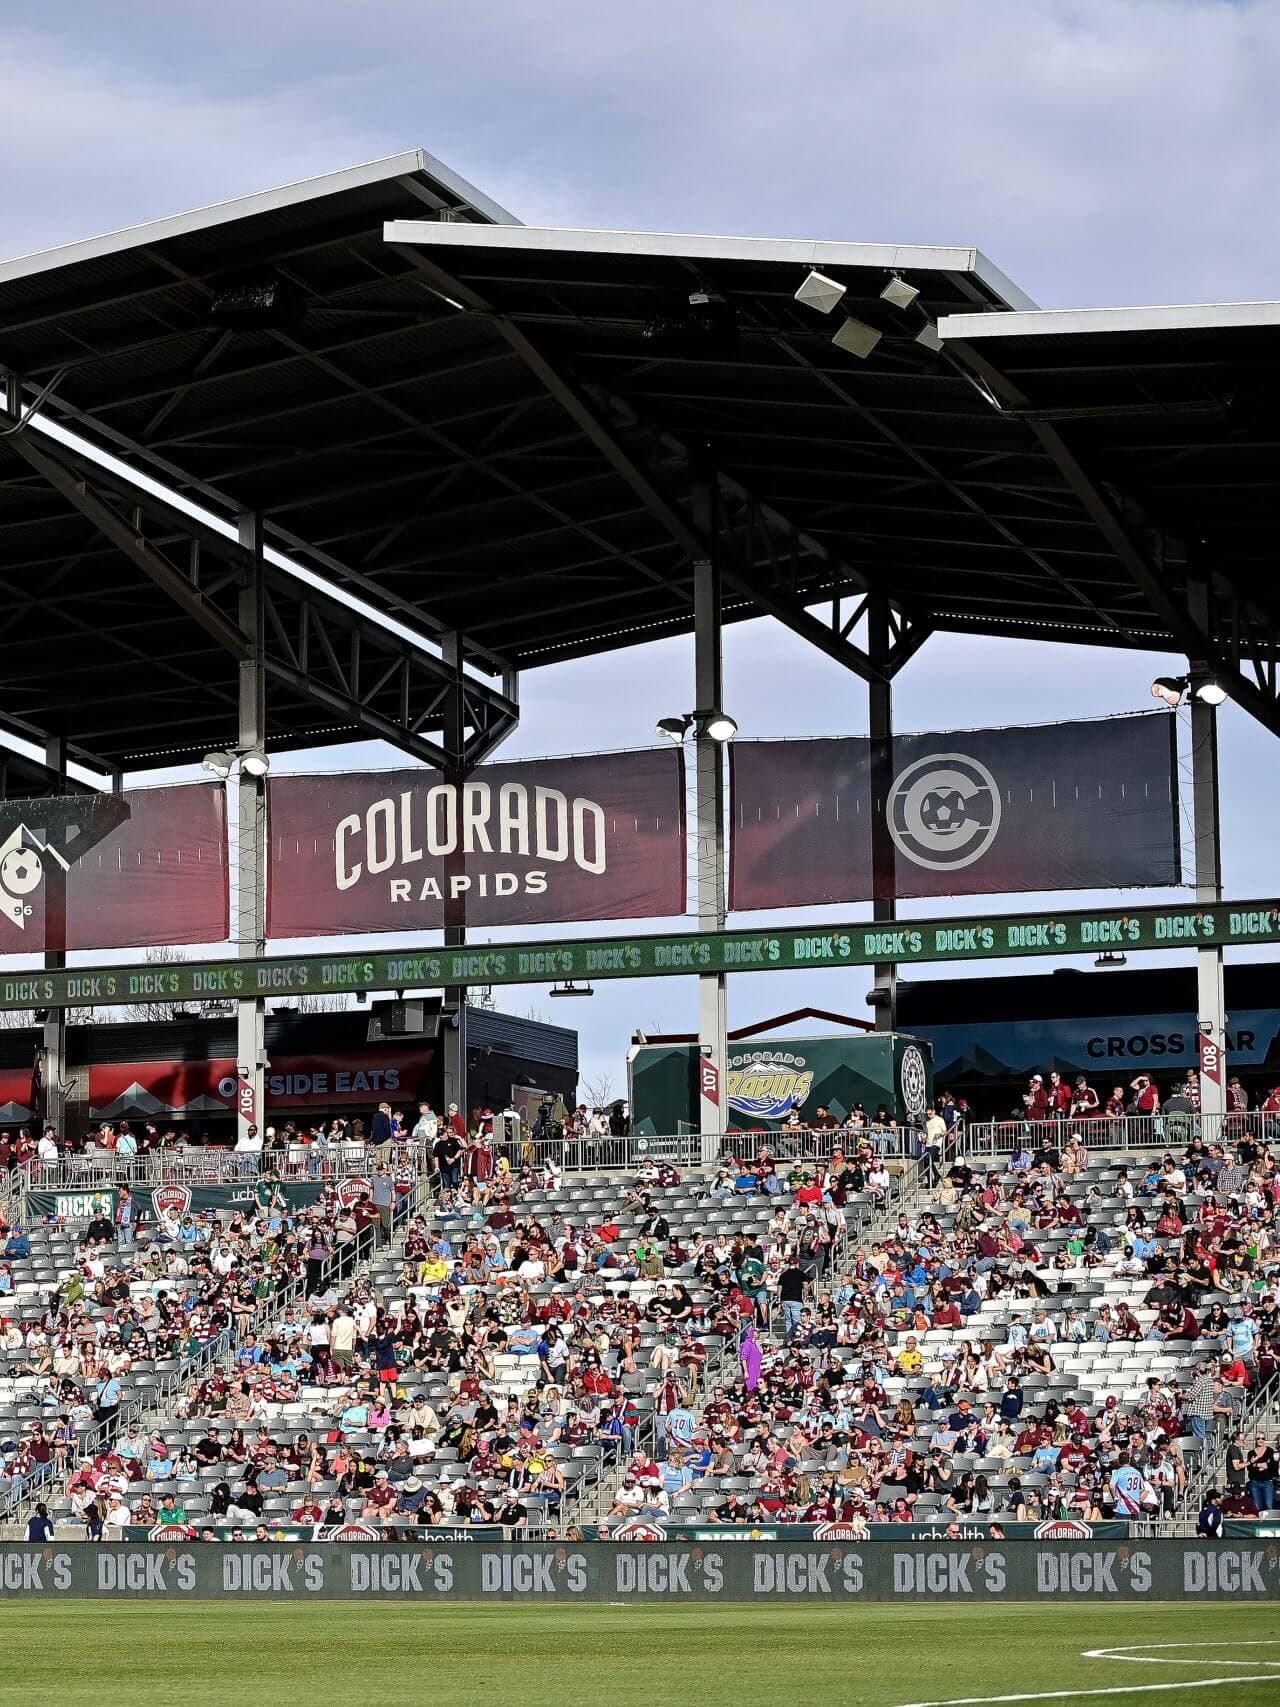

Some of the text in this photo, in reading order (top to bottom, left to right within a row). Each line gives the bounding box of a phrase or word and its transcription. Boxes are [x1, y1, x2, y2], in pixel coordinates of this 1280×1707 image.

[335, 781, 606, 891] COLORADO
[390, 871, 548, 903] RAPIDS
[14, 905, 33, 916] 96
[6, 980, 52, 1001] DICKS
[68, 977, 115, 998] DICKS
[586, 945, 639, 970] DICK'S
[655, 941, 709, 966] DICK'S
[724, 937, 779, 963] DICK'S
[794, 933, 850, 959] DICK'S
[865, 929, 920, 955] DICK'S
[936, 925, 992, 951] DICK'S
[1008, 921, 1066, 947] DICK'S
[1082, 917, 1139, 943] DICK'S
[1156, 912, 1213, 939] DICK'S
[1230, 908, 1280, 935] DICK'
[1087, 1033, 1184, 1058] CROSS
[1203, 1045, 1217, 1072] 108
[218, 1070, 400, 1097] OSIDE EATS
[703, 1068, 716, 1092] 107
[726, 1071, 814, 1107] RAPIDS
[241, 1088, 253, 1112] 106
[57, 1191, 111, 1216] DICK'S
[823, 1529, 860, 1541] COLORA
[98, 1547, 196, 1591] DICK'S
[223, 1548, 324, 1591] DICK'S
[350, 1549, 454, 1592] DICK'S
[482, 1548, 587, 1592] DICK'S
[616, 1548, 723, 1592] DICK'S
[754, 1548, 864, 1593] DICK'S
[894, 1547, 1007, 1593] DICK'S
[1037, 1546, 1152, 1592] DICK'S
[1184, 1545, 1280, 1592] DICK'
